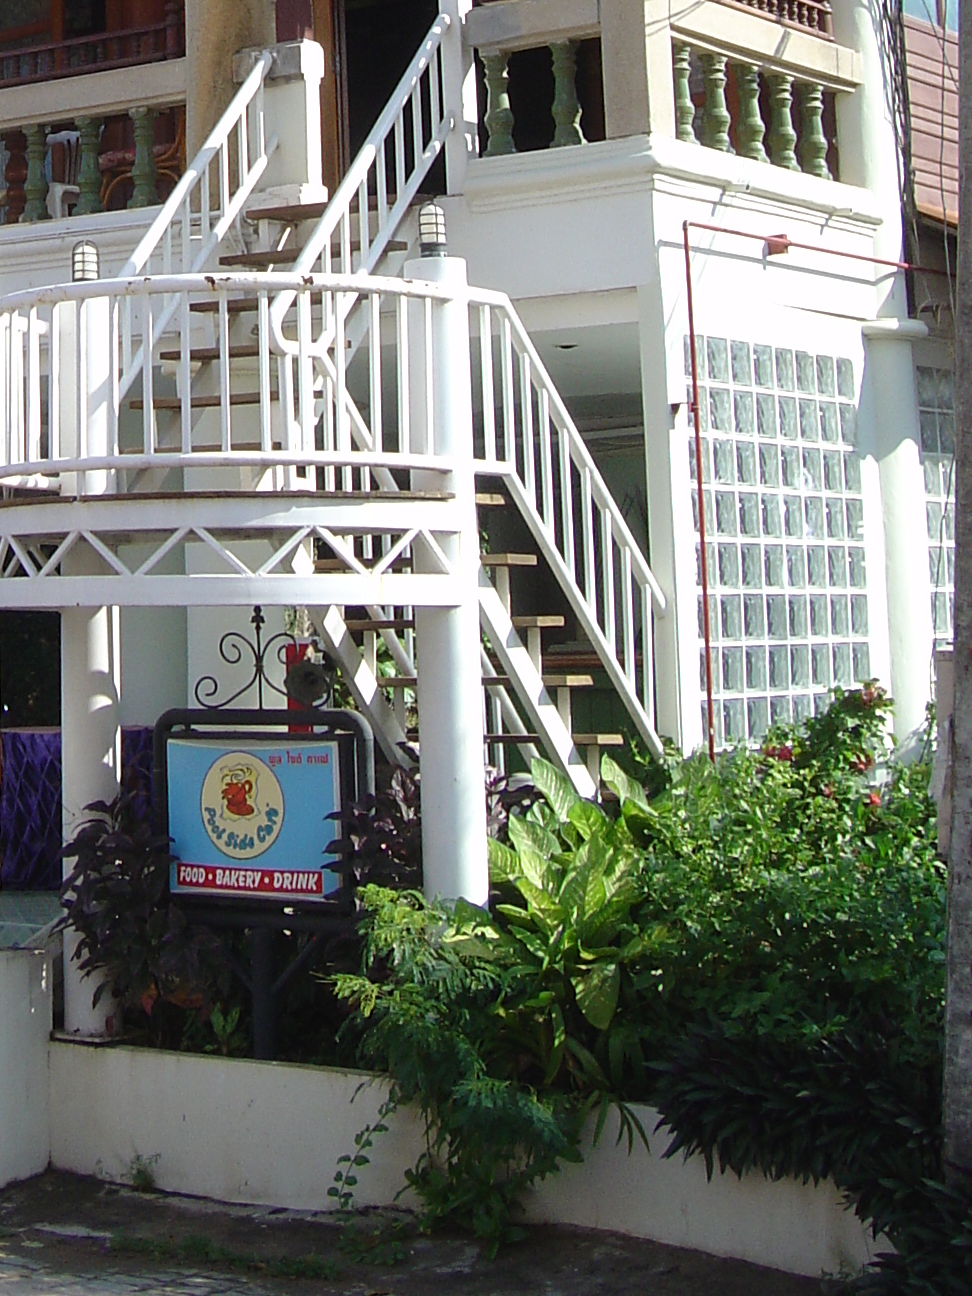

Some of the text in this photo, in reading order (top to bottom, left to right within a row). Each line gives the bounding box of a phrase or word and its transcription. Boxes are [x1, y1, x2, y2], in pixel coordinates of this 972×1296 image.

[225, 831, 255, 850] Side
[179, 866, 319, 891] FOOD BAKERY DRINK
